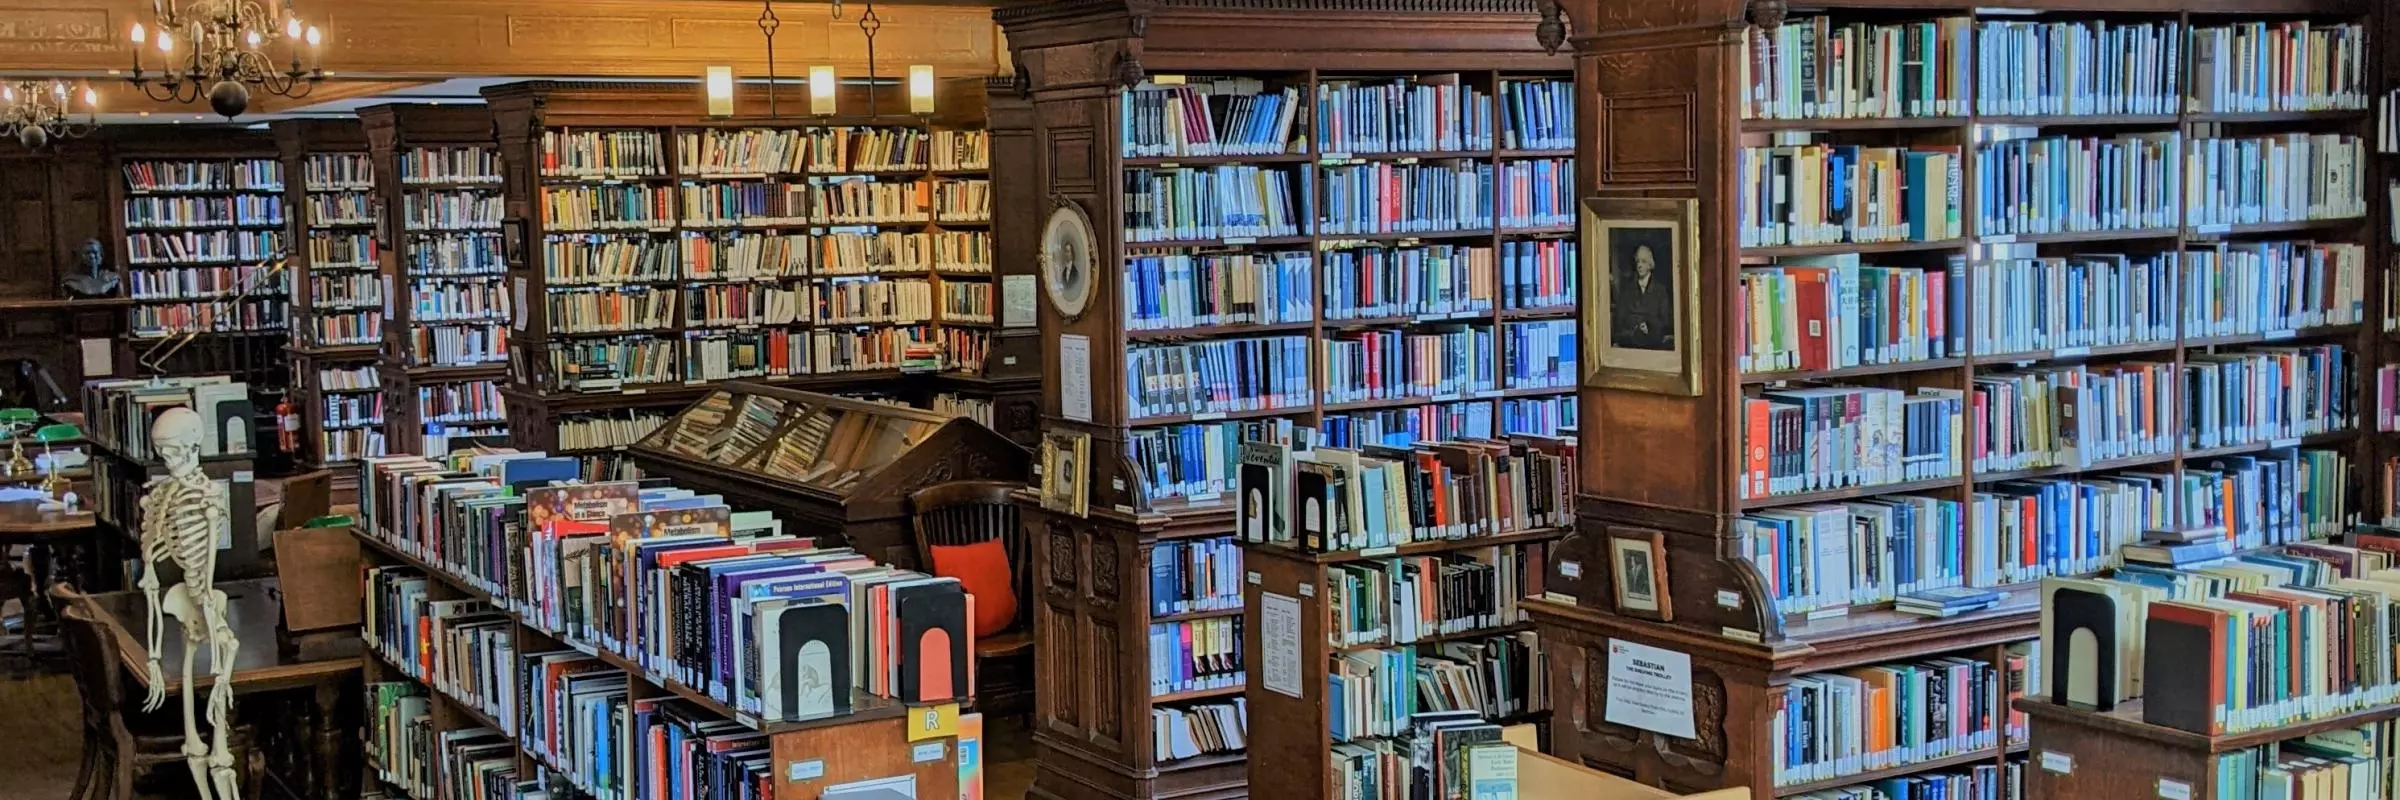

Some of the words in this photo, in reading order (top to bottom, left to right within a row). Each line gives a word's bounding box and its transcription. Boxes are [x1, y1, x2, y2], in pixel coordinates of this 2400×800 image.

[574, 500, 608, 509] Metabolism
[663, 526, 701, 536] Metabolism
[773, 585, 793, 593] Pearson
[794, 581, 825, 592] International
[826, 580, 843, 589] Edition
[1632, 659, 1665, 672] SEBASTIAN
[925, 710, 940, 731] R
